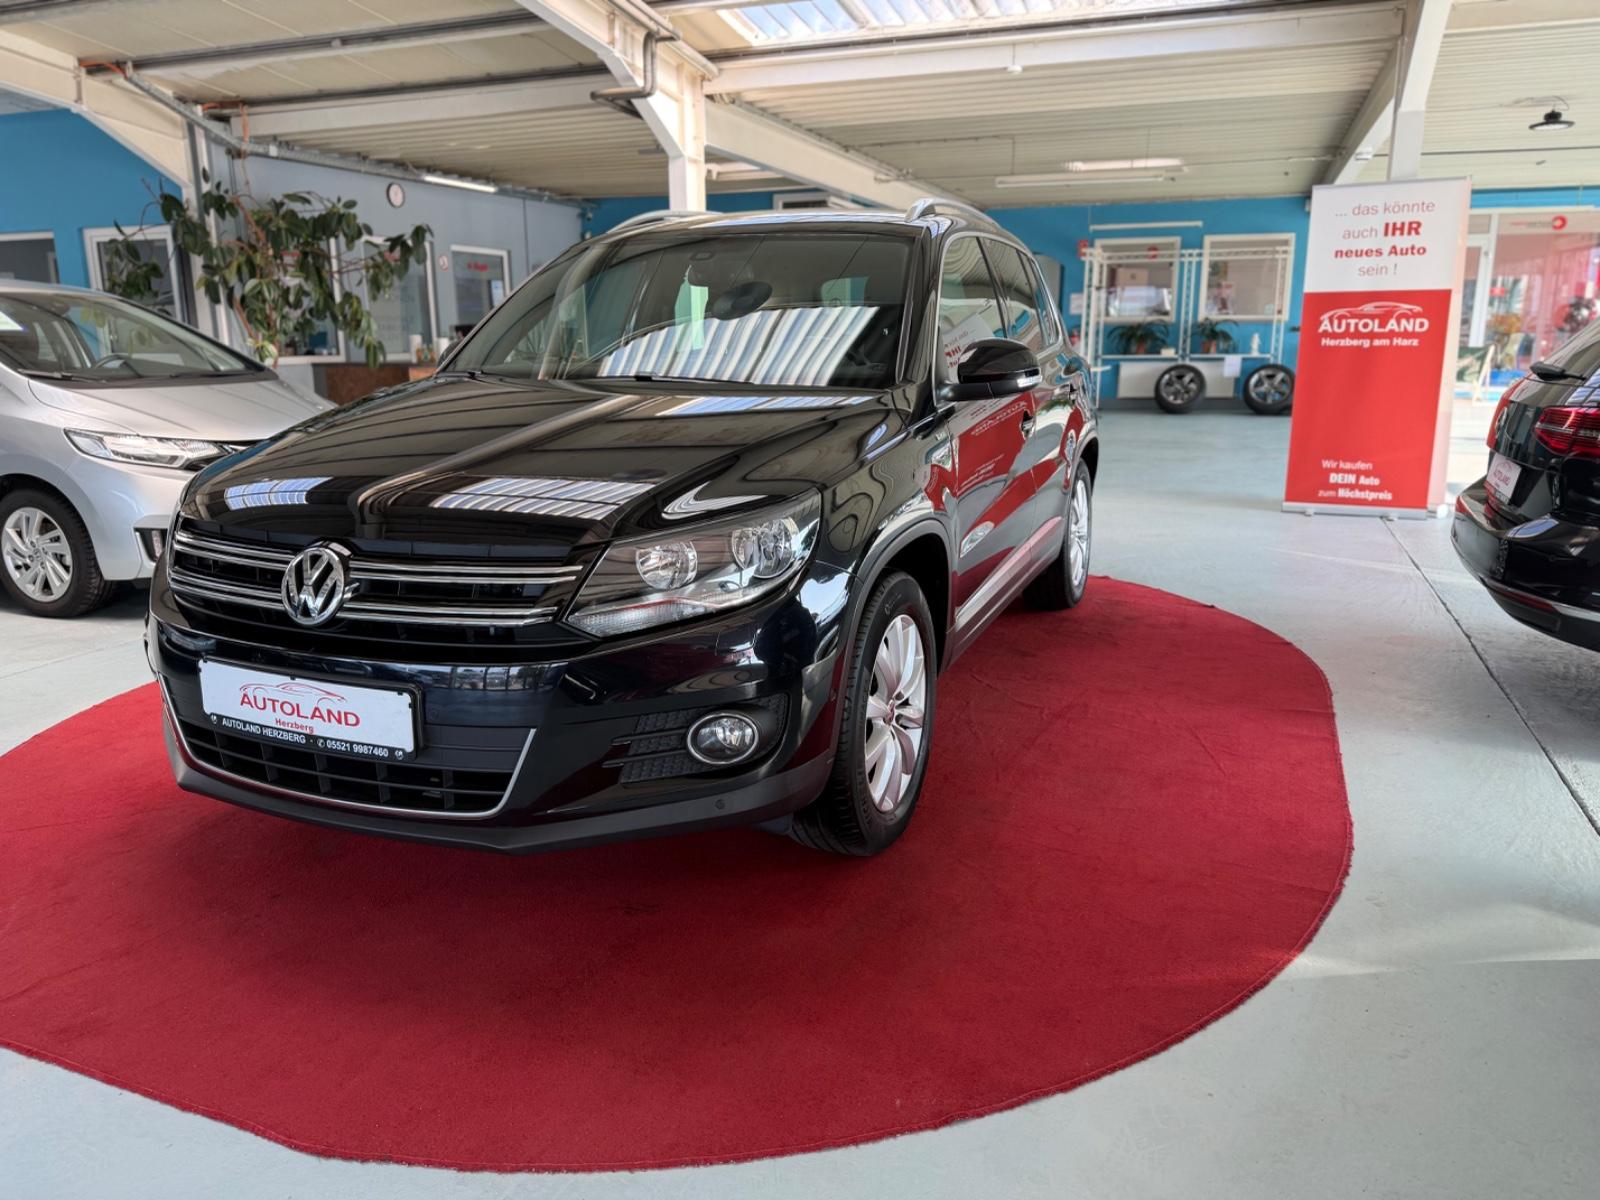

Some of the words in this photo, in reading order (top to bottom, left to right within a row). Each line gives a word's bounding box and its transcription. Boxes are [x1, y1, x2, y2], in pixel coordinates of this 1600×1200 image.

[1352, 203, 1379, 216] das
[1383, 200, 1436, 215] könnte
[1342, 226, 1379, 240] auch
[1383, 220, 1422, 237] IHR
[1334, 248, 1383, 259] neues
[1387, 245, 1427, 257] Auto
[1357, 264, 1389, 277] sein
[1318, 317, 1429, 333] AUTOLAND
[1321, 337, 1370, 348] Herzberg
[1372, 338, 1390, 346] am
[1392, 336, 1419, 346] Harz
[1321, 459, 1338, 469] Wir
[1339, 460, 1373, 471] kaufen
[1329, 473, 1356, 484] DEIN
[1359, 476, 1380, 486] Auto
[1317, 489, 1336, 498] zum
[1338, 487, 1393, 501] Höchstpreis
[240, 693, 361, 727] AUTOLAND
[275, 717, 314, 734] Herzberg
[222, 717, 261, 735] AUTOLAND
[262, 727, 306, 744] HERZBERG
[326, 740, 351, 752] 05521
[352, 743, 389, 757] 9987460
